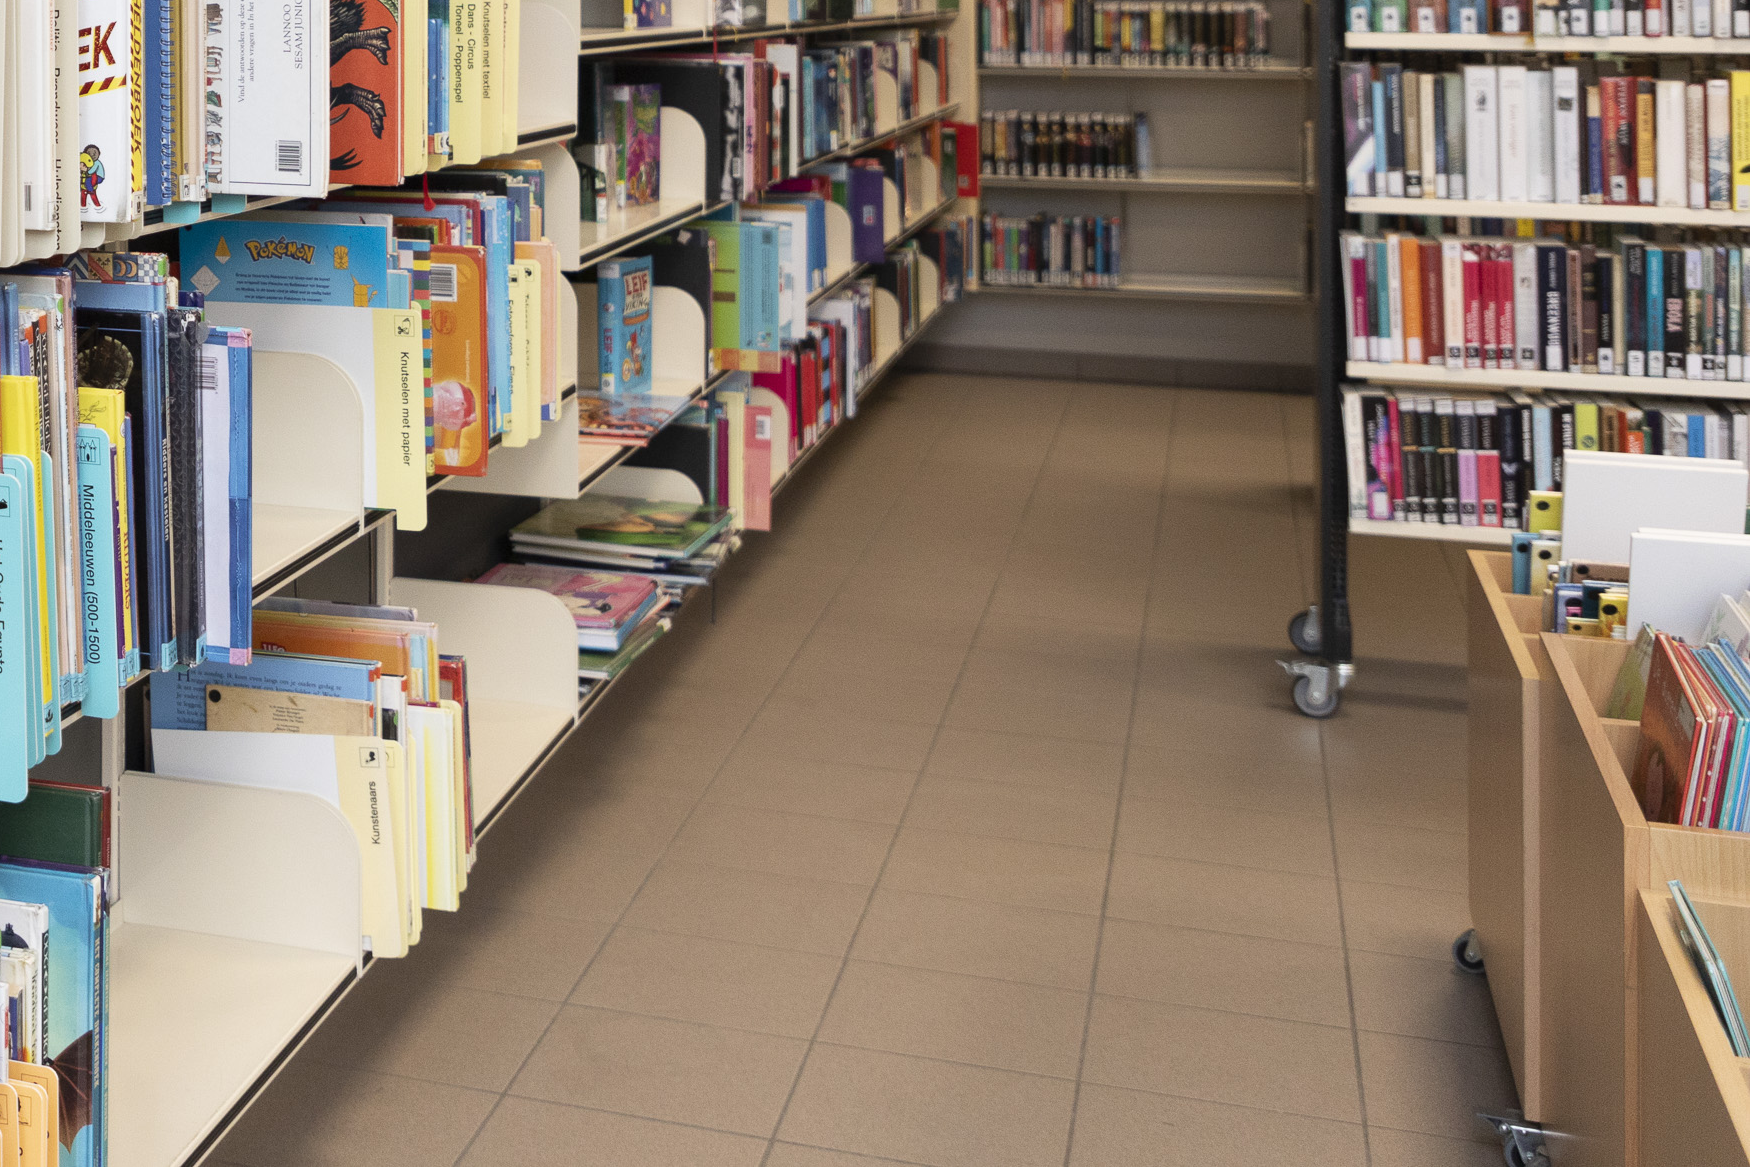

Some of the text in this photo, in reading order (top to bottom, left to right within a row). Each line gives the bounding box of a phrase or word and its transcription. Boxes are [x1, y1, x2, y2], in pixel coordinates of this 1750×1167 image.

[239, 20, 247, 30] op
[282, 4, 291, 53] LANNOO
[467, 3, 476, 70] Dans Circus
[294, 32, 303, 70] SESAM
[452, 3, 464, 103] Toneel Poppenspel
[482, 1, 491, 99] Knutselen met textiel
[238, 74, 245, 84] de
[238, 85, 246, 102] Vind
[624, 272, 648, 296] LEIF
[1665, 297, 1683, 332] EBOLA
[603, 327, 614, 355] LEIF
[43, 382, 52, 454] GETUIGEN
[400, 350, 411, 467] Knutselen met papier
[163, 496, 171, 542] kastelen
[83, 484, 100, 665] Middeleeuwen (500-1500)
[371, 780, 381, 845] Kunstenaars
